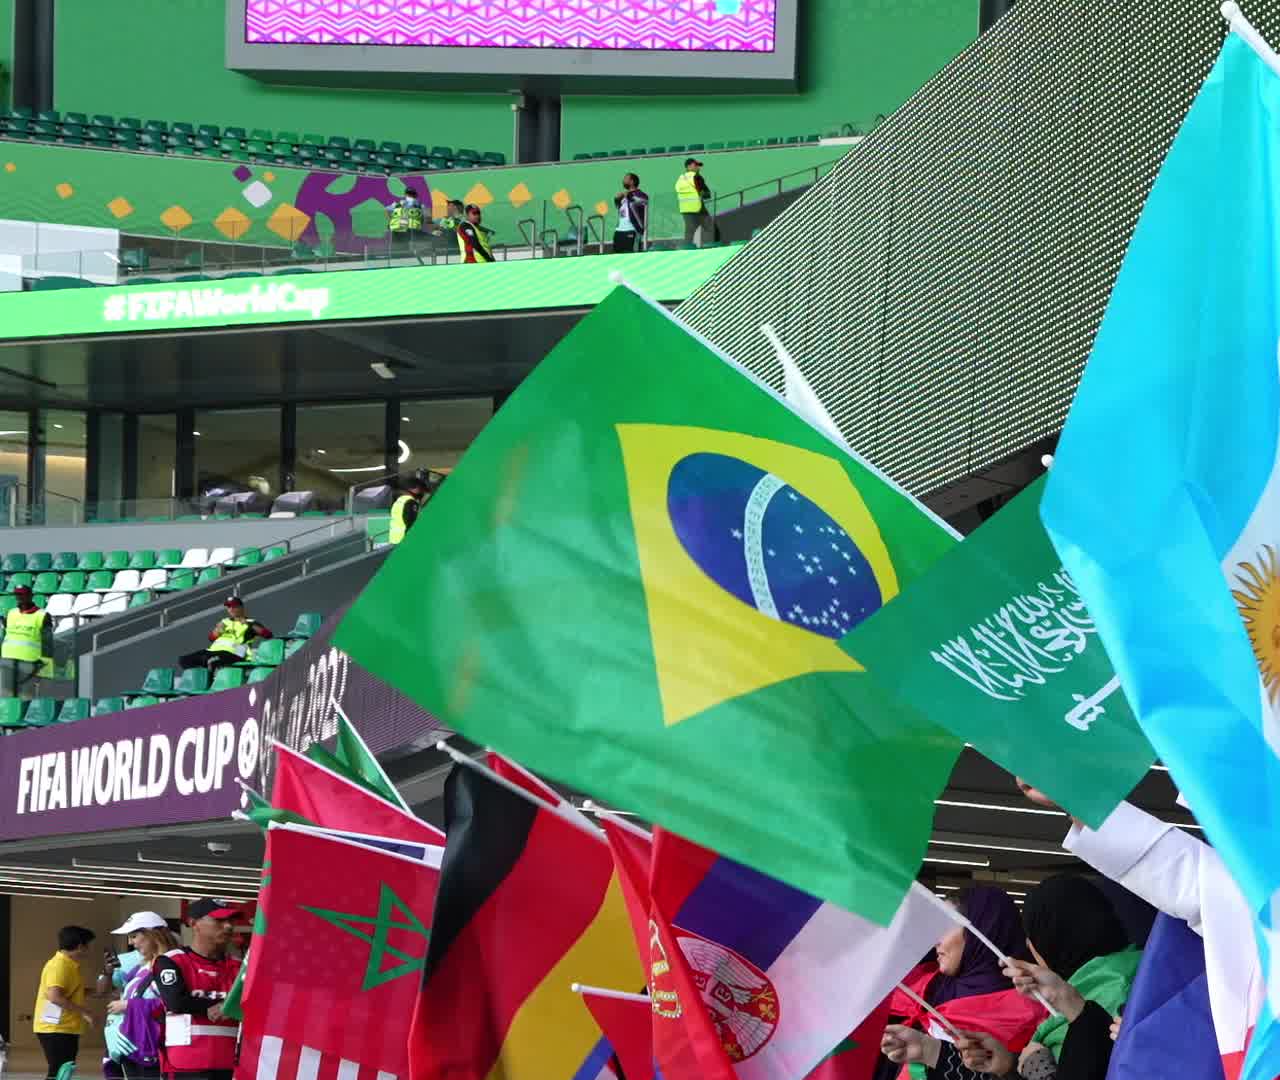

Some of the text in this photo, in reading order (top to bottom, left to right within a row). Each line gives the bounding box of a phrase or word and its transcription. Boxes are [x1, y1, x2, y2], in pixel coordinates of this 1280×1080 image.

[104, 283, 328, 320] #FIFAWorldCup
[17, 722, 235, 814] FIFA WORLD CUP
